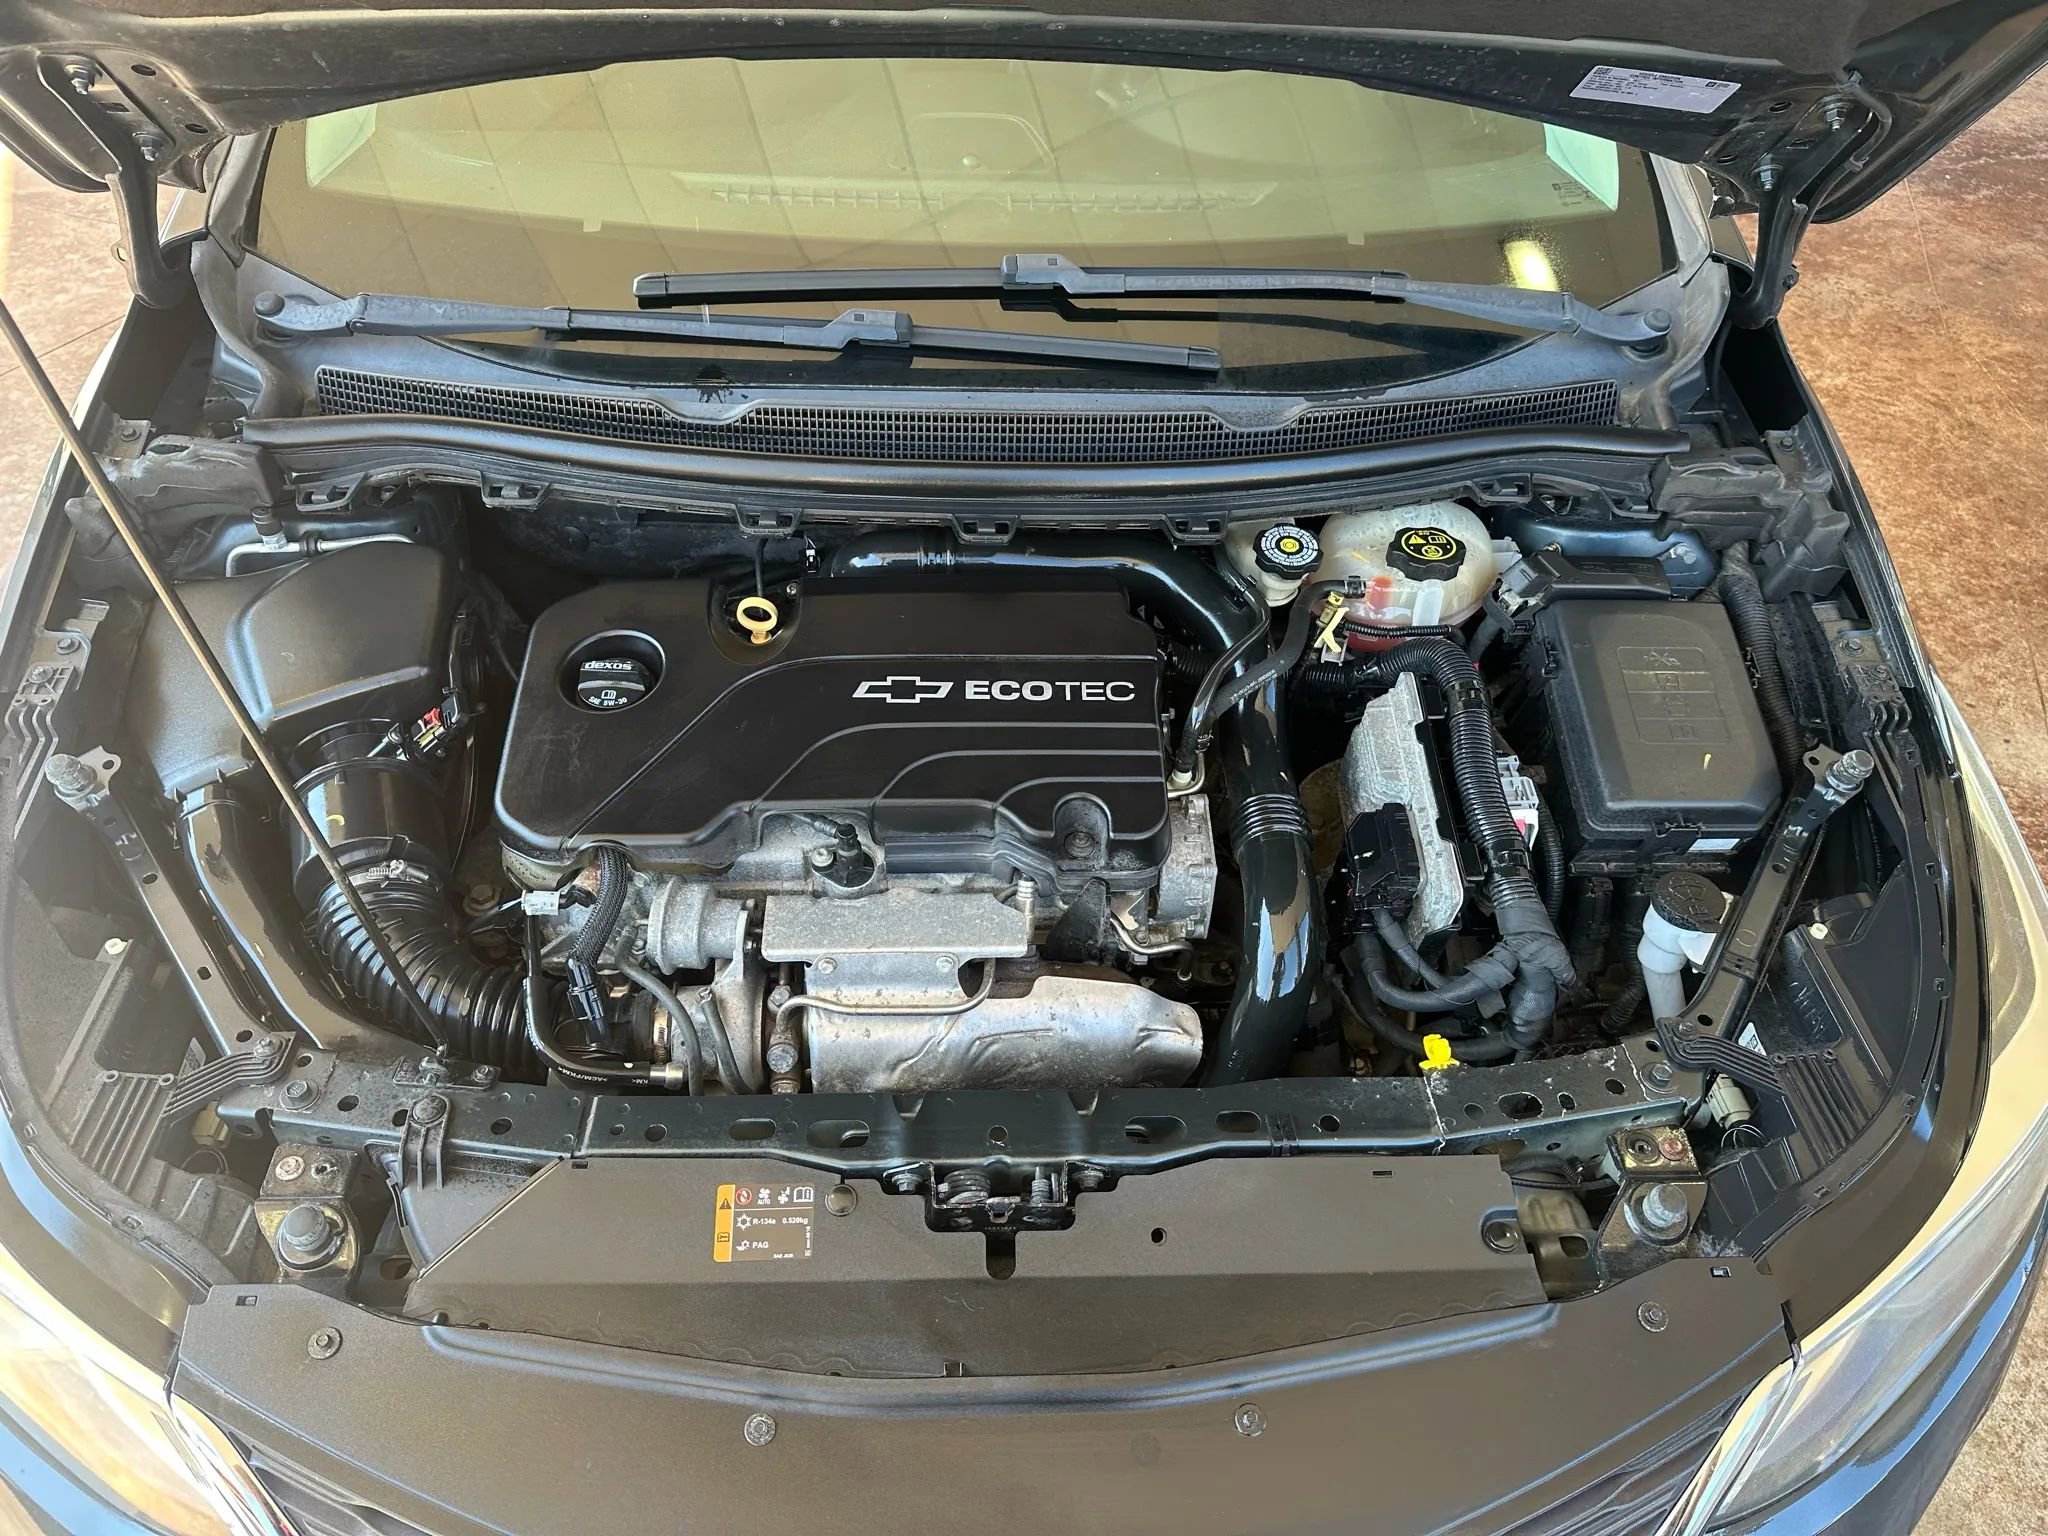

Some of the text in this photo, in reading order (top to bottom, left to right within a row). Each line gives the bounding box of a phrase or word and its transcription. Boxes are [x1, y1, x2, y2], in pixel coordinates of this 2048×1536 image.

[584, 661, 632, 670] dexos
[965, 680, 1135, 701] ECOTEC
[588, 696, 628, 706] SAE 5W-30
[752, 1241, 769, 1249] PAG
